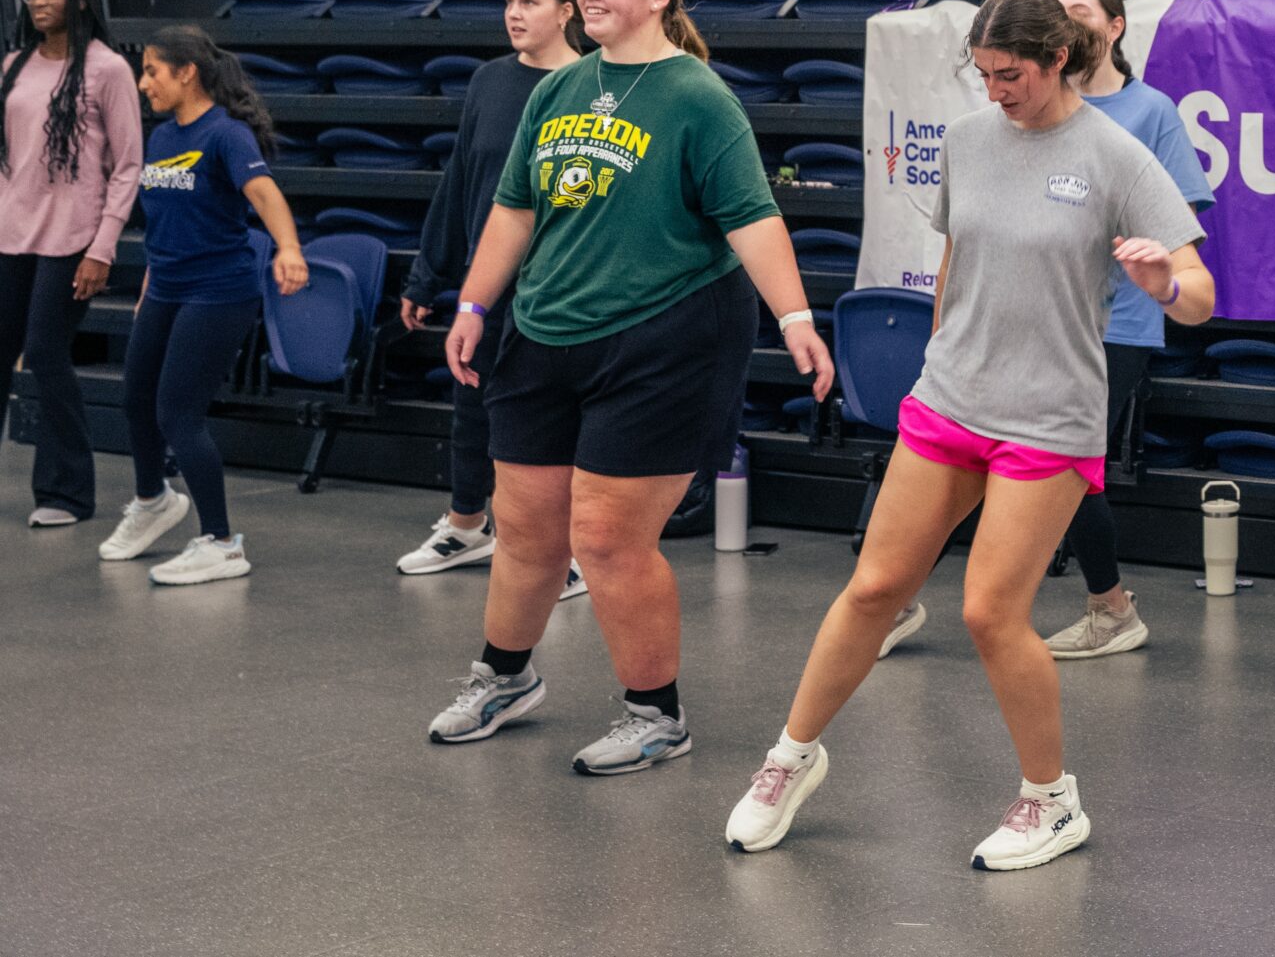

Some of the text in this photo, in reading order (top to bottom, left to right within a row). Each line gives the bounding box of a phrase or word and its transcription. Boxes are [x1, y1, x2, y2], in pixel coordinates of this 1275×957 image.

[538, 113, 652, 159] OREGON
[554, 144, 578, 156] FOUR
[1050, 812, 1073, 836] HOKA
